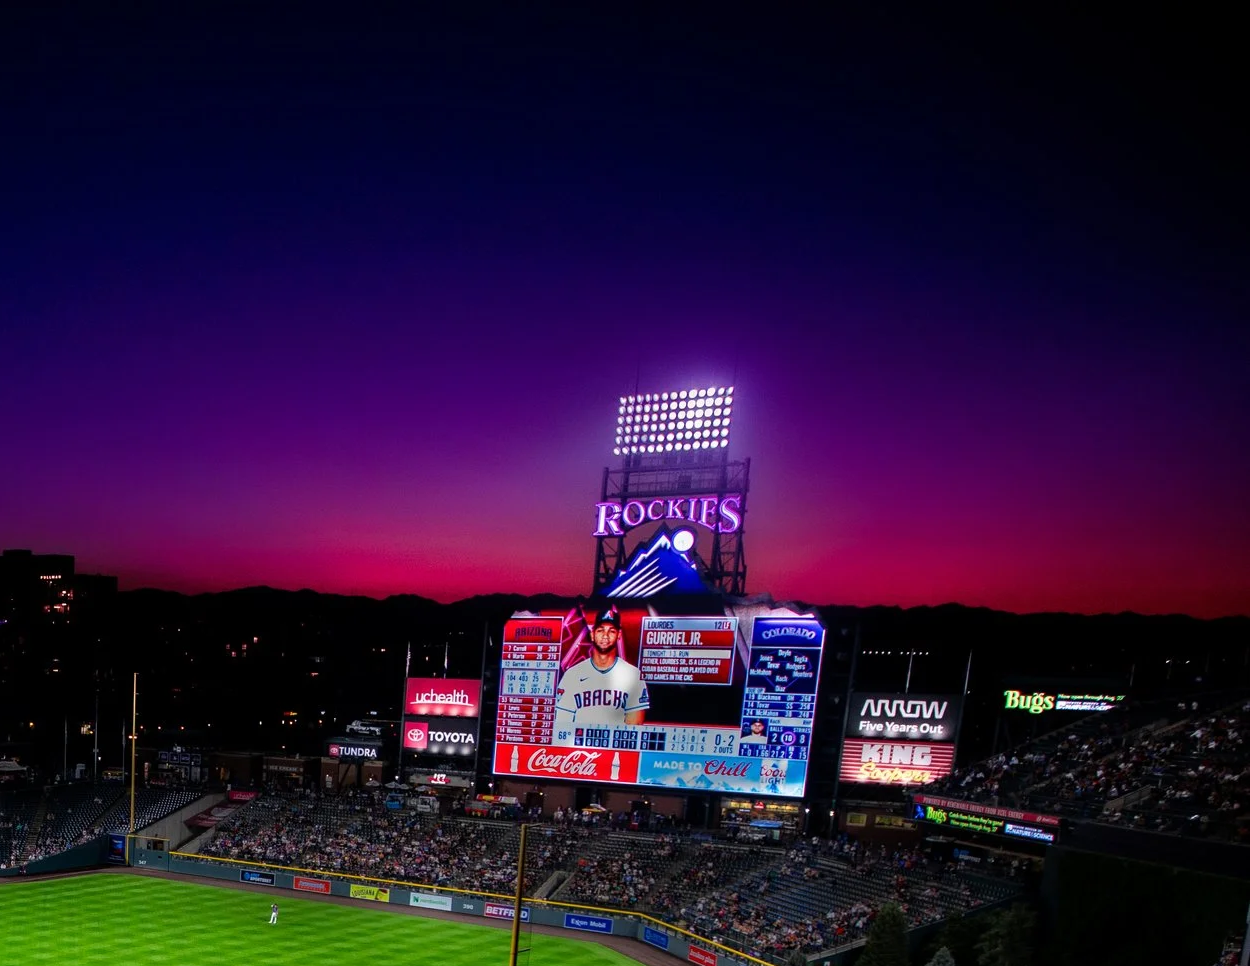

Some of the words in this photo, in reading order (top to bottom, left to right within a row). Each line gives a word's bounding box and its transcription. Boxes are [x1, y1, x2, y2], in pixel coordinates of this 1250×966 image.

[593, 495, 742, 537] ROCKIES
[648, 621, 674, 630] LOURDES
[514, 626, 552, 640] ARIZONA
[646, 631, 688, 645] GURRIEL
[688, 631, 703, 645] JR.
[762, 627, 816, 640] COLORADO
[778, 650, 792, 658] Doyle
[416, 688, 468, 705] uchealth
[574, 689, 629, 709] DBACKS
[1004, 690, 1055, 714] Bugs
[860, 699, 948, 719] ARROW
[859, 721, 883, 732] Five
[885, 722, 918, 733] Years
[920, 723, 943, 734] Out
[428, 731, 474, 744] TOYOTA
[772, 734, 777, 742] 2
[785, 734, 792, 742] 10
[800, 735, 805, 743] 8
[339, 746, 377, 757] TUNDRA
[861, 744, 932, 766] KING
[528, 748, 602, 776] Coca-Cola
[654, 761, 684, 770] MADE
[688, 762, 702, 770] TO
[704, 760, 752, 777] Chill
[926, 806, 947, 824] Bugs
[486, 905, 528, 918] BETFRD
[571, 918, 588, 927] Exxon
